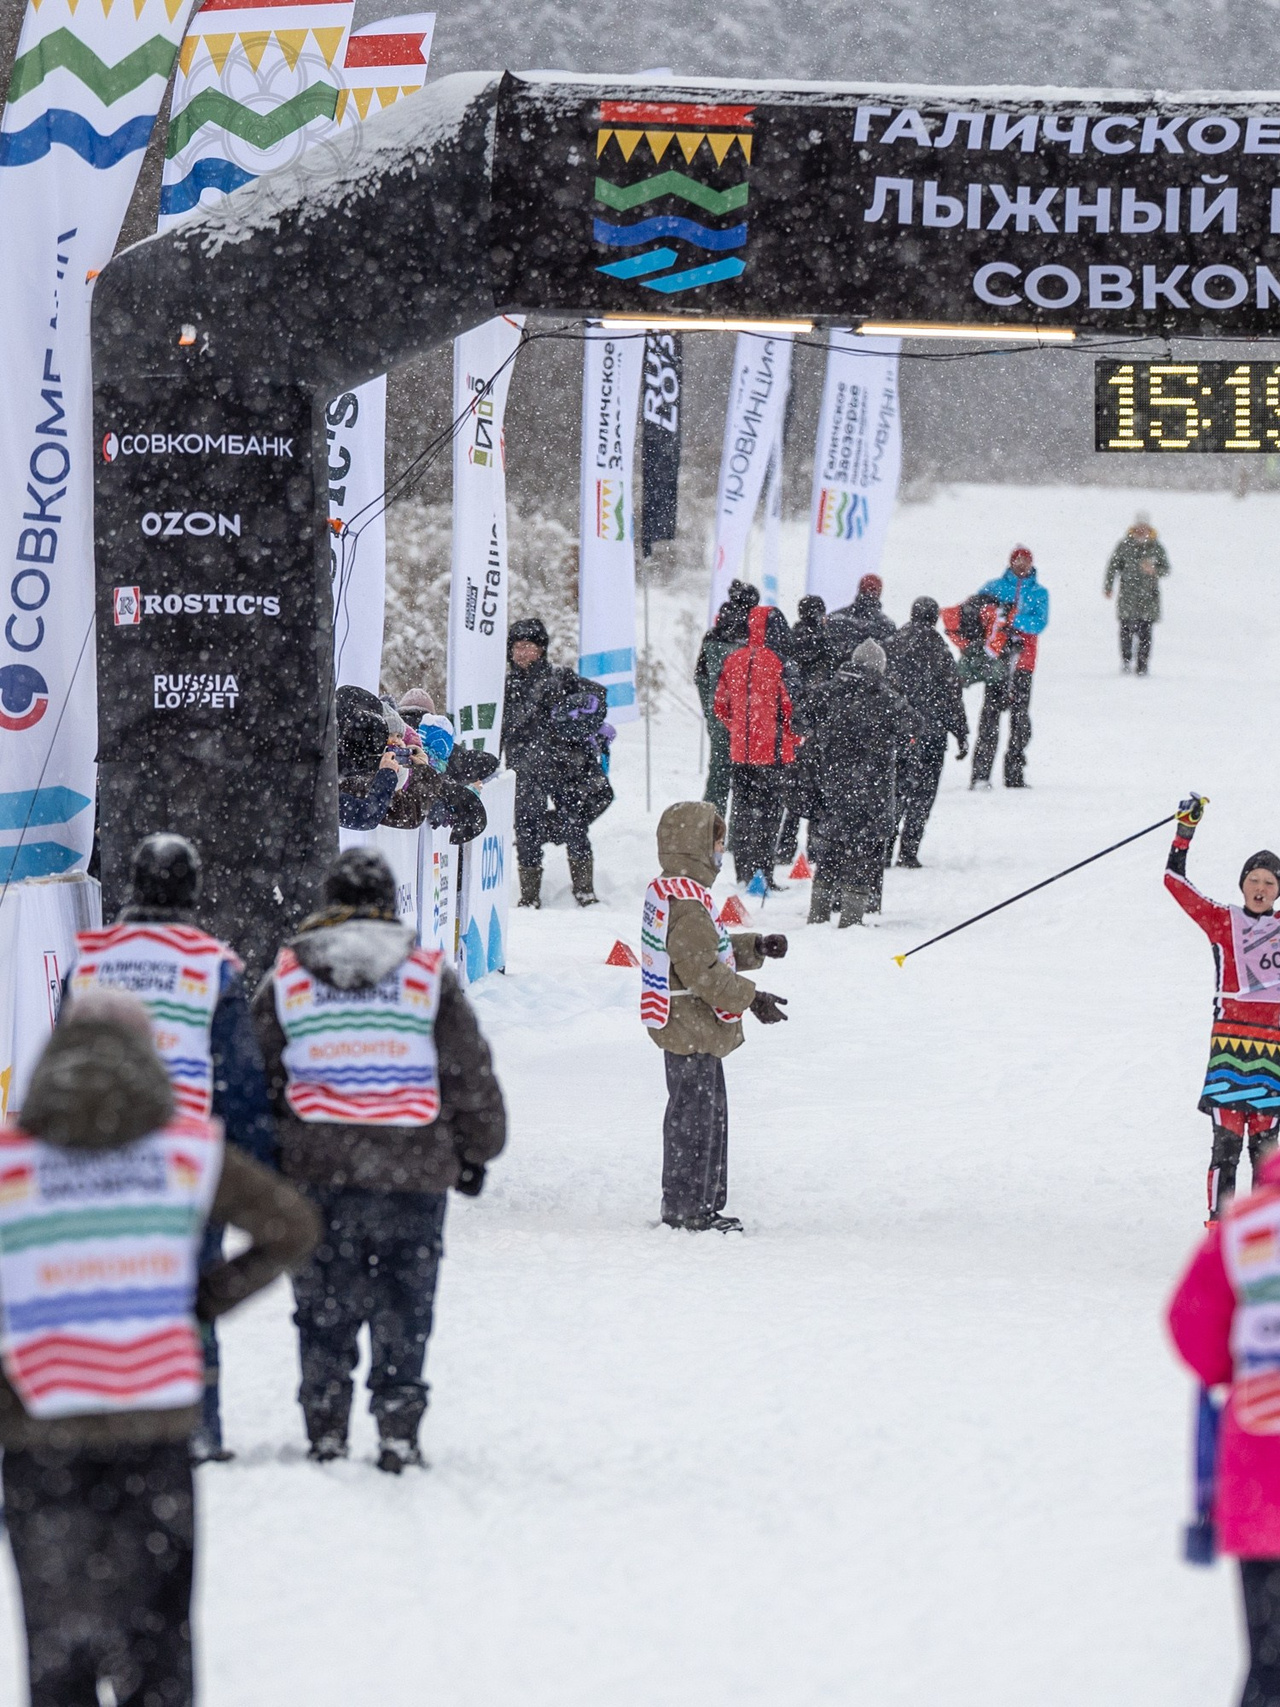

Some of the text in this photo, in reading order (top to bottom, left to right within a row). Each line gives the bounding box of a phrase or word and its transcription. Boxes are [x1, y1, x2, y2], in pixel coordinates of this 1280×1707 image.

[120, 433, 293, 458] СОВКОМБАНК
[141, 511, 241, 537] OZON
[144, 594, 281, 616] ROSTIC'S
[154, 674, 239, 692] RUSSIA
[154, 691, 239, 709] LOPPET
[481, 834, 504, 892] OZON
